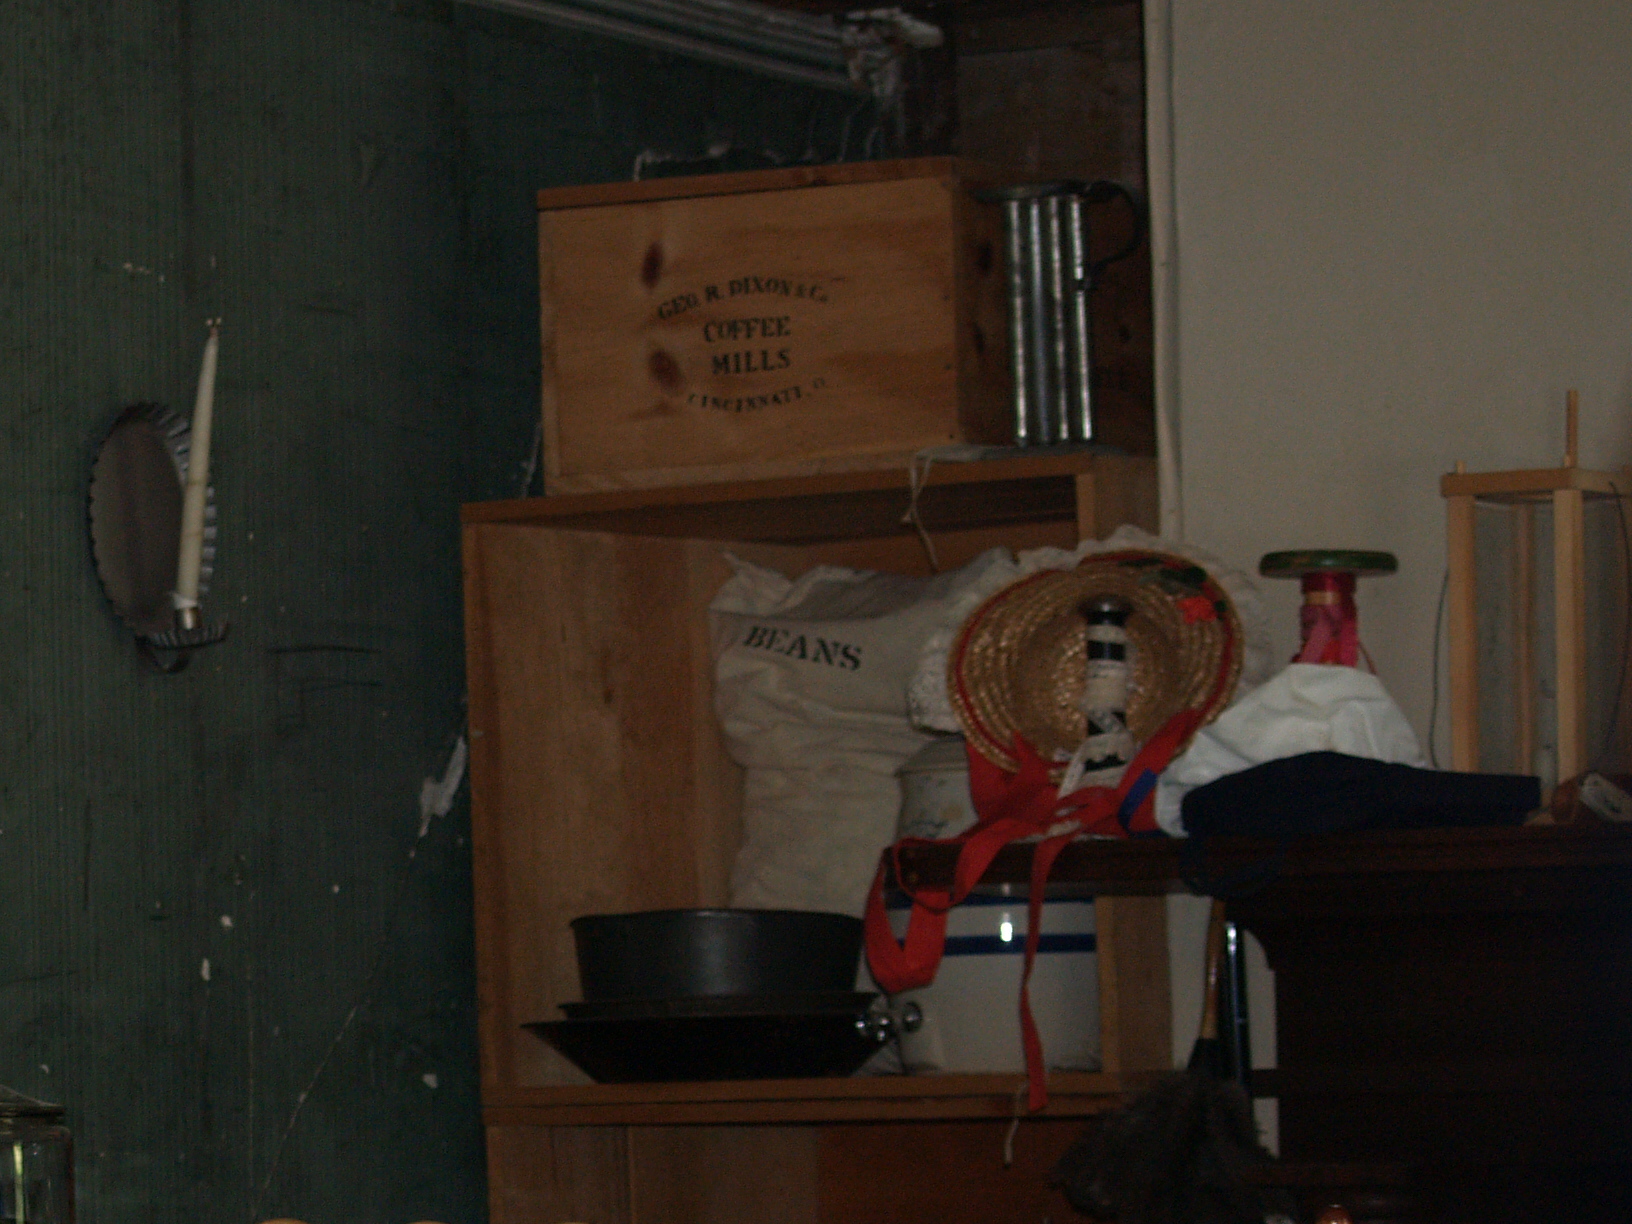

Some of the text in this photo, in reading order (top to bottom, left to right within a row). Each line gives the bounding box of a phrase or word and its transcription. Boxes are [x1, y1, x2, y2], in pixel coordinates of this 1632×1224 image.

[703, 316, 791, 342] COFFEE
[712, 350, 791, 374] MILLS
[743, 626, 862, 671] BEANS
